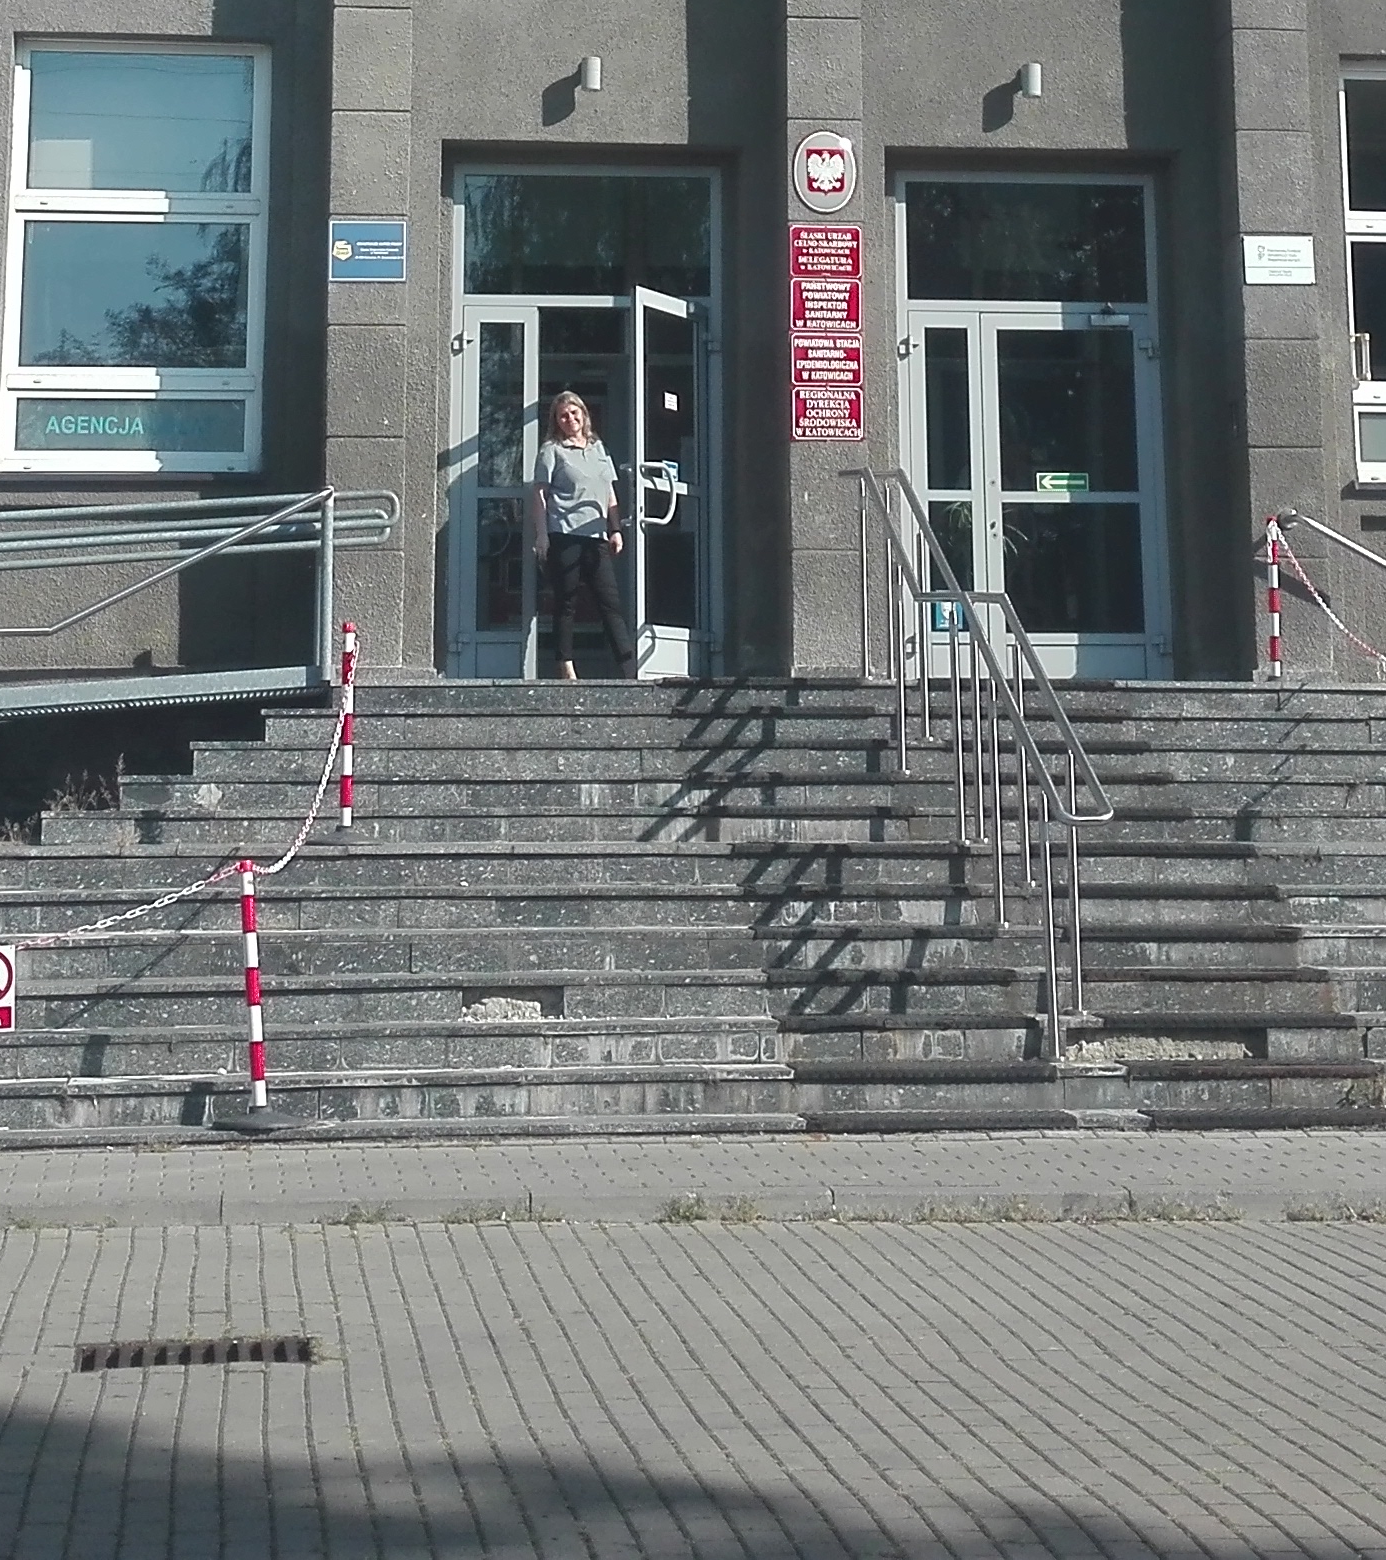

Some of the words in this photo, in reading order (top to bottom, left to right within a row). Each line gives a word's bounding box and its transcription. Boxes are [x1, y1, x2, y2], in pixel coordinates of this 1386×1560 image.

[805, 301, 848, 310] INSPEKTOR
[805, 310, 848, 319] SANITARNY
[806, 320, 857, 328] KATOWICACH
[802, 371, 809, 380] W
[811, 371, 853, 380] KATOWICACH
[799, 390, 856, 400] REGIONALNA
[806, 400, 850, 408] DYREKCJA
[806, 409, 850, 418] OCHRONY
[45, 415, 144, 435] AGENCJA
[799, 416, 857, 427] ŚRODOWISKA
[796, 428, 803, 436] W
[805, 428, 862, 436] KATOWICACH
